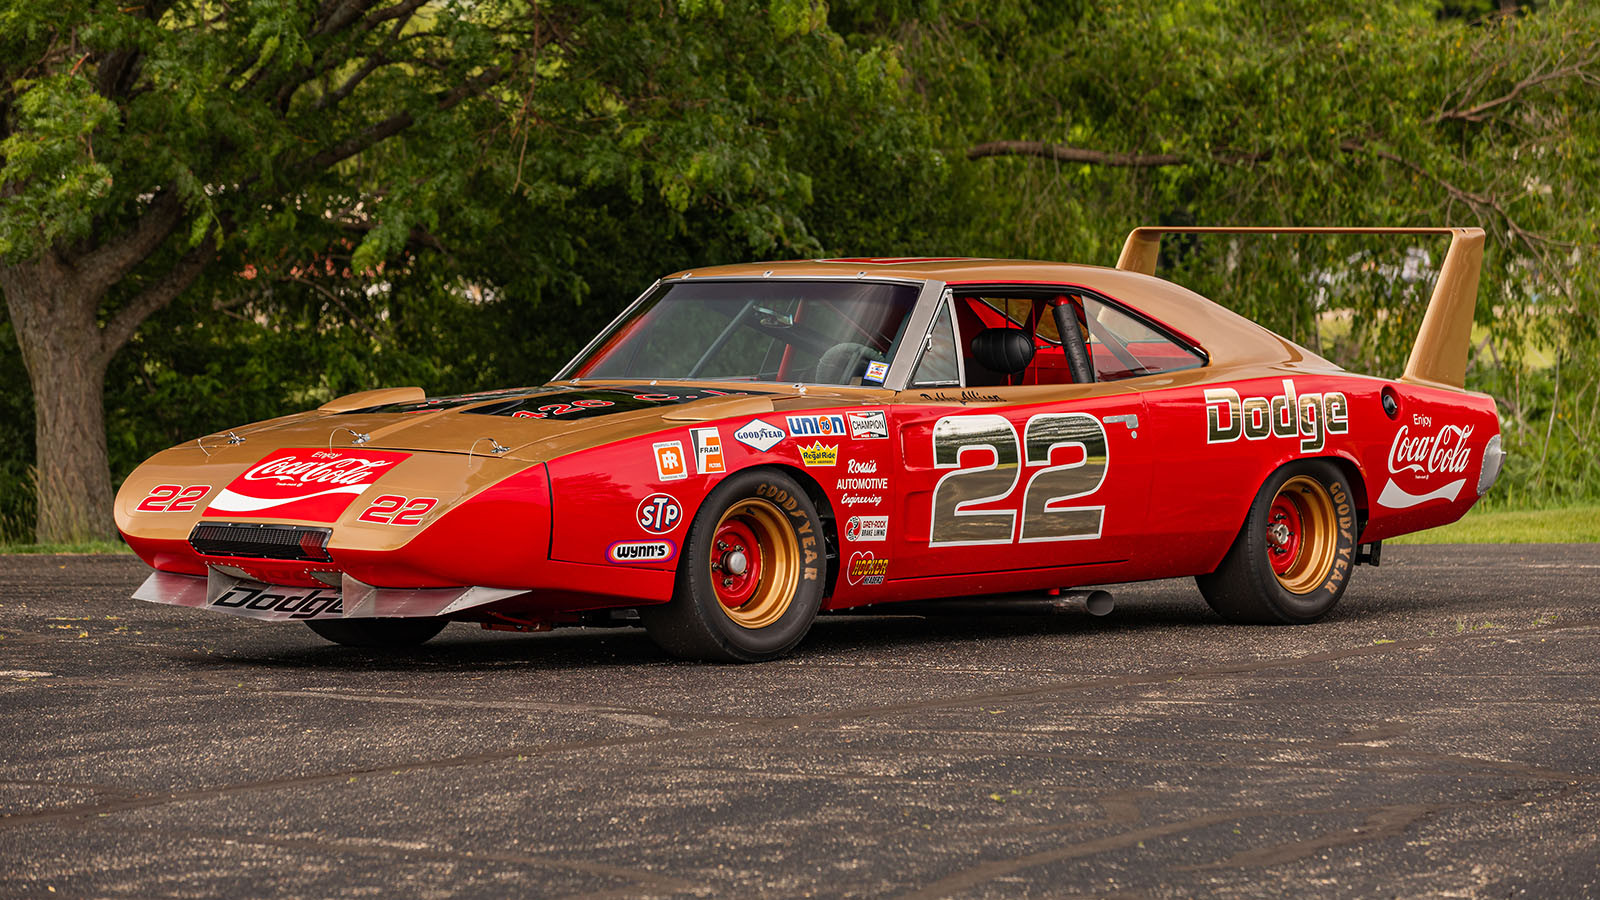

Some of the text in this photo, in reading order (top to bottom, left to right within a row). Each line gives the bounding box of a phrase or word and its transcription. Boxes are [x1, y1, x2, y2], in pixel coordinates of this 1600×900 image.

[1203, 379, 1349, 454] Dodge
[1412, 413, 1432, 428] Enjoy
[820, 421, 830, 431] 76
[852, 420, 884, 431] CHAMPION
[311, 451, 342, 459] Enjoy
[700, 446, 719, 454] FRAM
[803, 451, 836, 460] Regal Ride
[1388, 424, 1475, 475] Coca-Cola
[244, 455, 394, 485] Coca-Cola
[836, 477, 888, 490] AUTOMOTIVE
[928, 412, 1110, 548] 22
[135, 484, 212, 513] 22
[841, 493, 882, 507] Engineering
[357, 494, 439, 527] 22
[641, 497, 680, 531] STP
[851, 559, 889, 576] HOOKER
